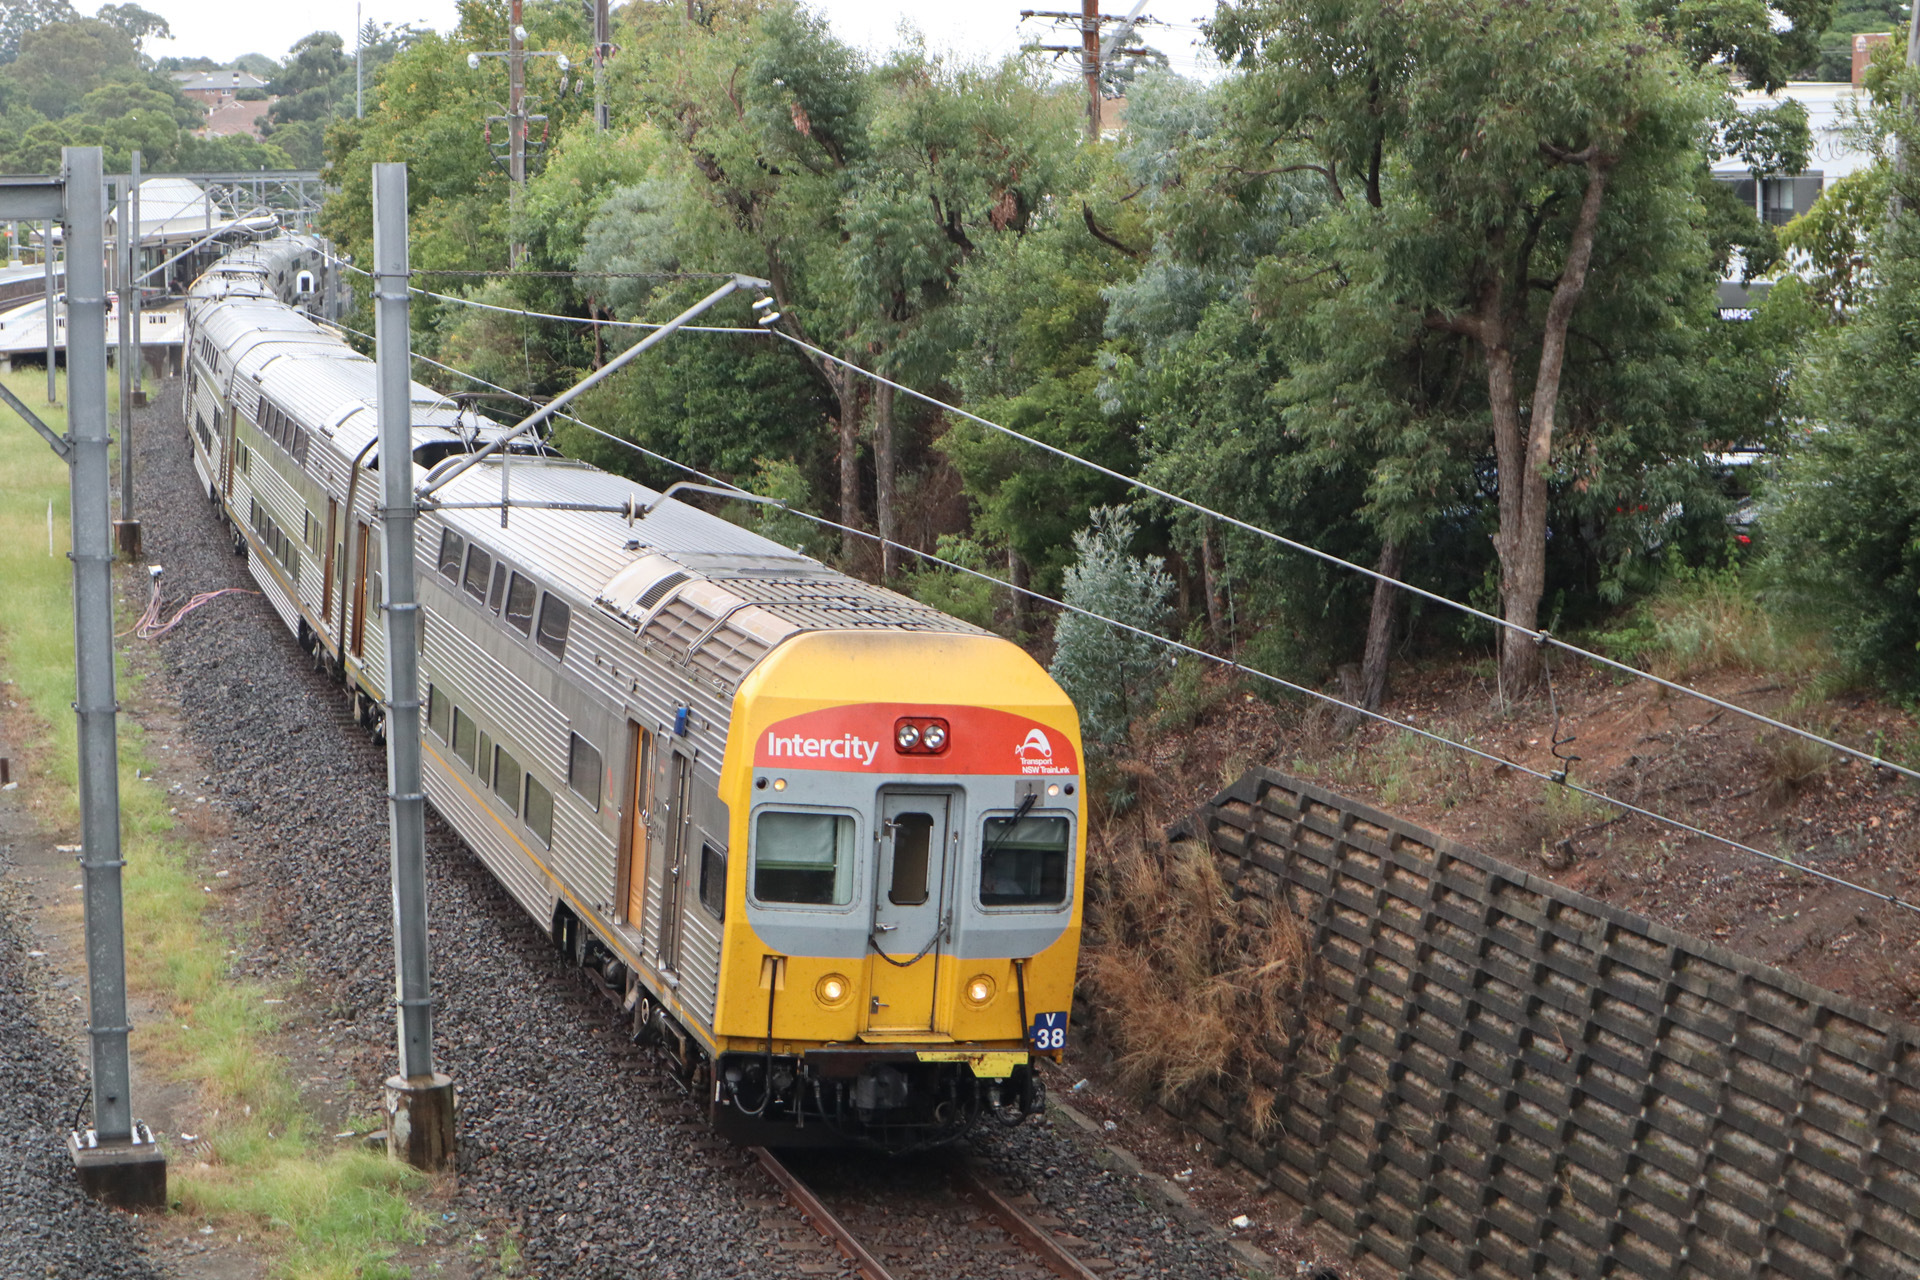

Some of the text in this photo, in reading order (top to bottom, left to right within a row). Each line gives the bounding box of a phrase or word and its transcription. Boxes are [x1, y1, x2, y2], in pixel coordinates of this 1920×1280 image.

[768, 732, 879, 766] Intercity
[1020, 757, 1053, 766] Transport
[1022, 766, 1070, 774] NSW TrainLink
[1045, 1012, 1056, 1027] V
[1036, 1028, 1064, 1049] 38
